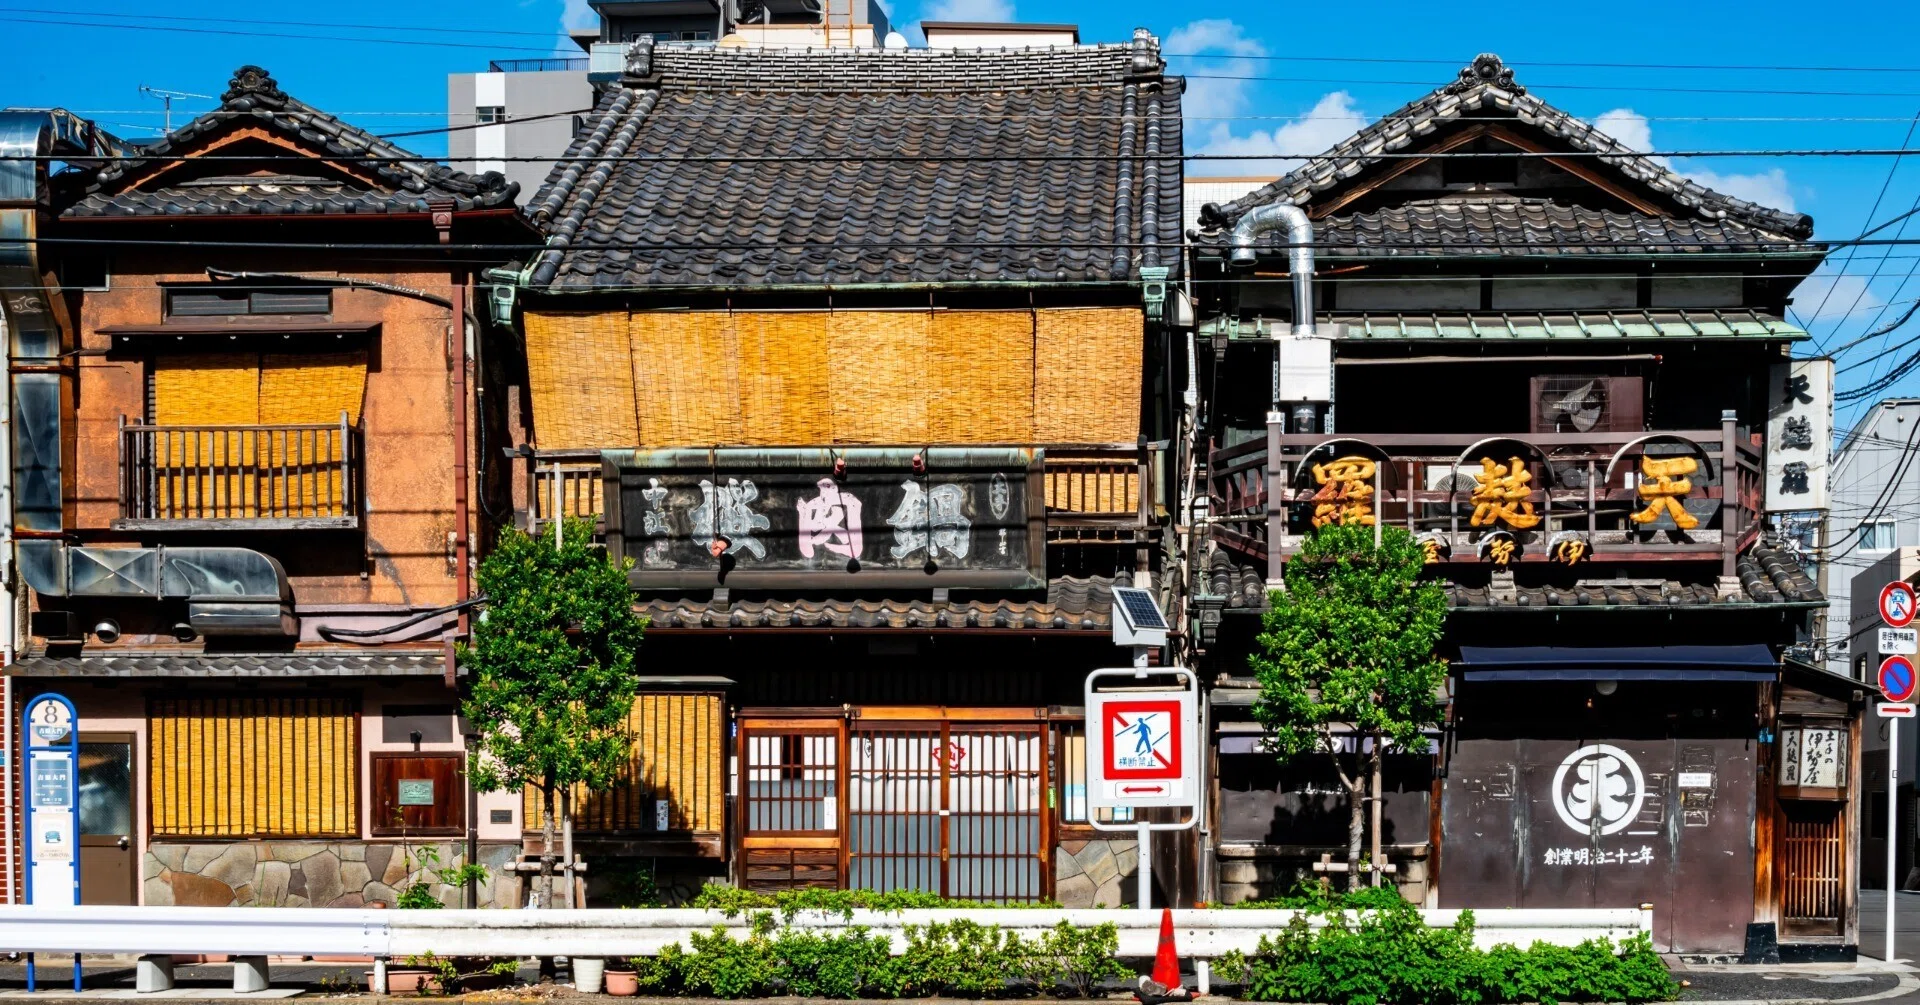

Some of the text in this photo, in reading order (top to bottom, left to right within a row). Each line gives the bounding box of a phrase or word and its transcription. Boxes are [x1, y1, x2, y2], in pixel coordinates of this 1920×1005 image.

[1882, 632, 1914, 641] 居住者用車両
[1882, 641, 1899, 650] を除く
[44, 705, 58, 724] 8
[1825, 730, 1836, 764] 土手の
[1118, 756, 1157, 767] 横断禁止
[1804, 732, 1823, 785] 伊勢屋
[1543, 845, 1655, 866] 創業明治二十二年
